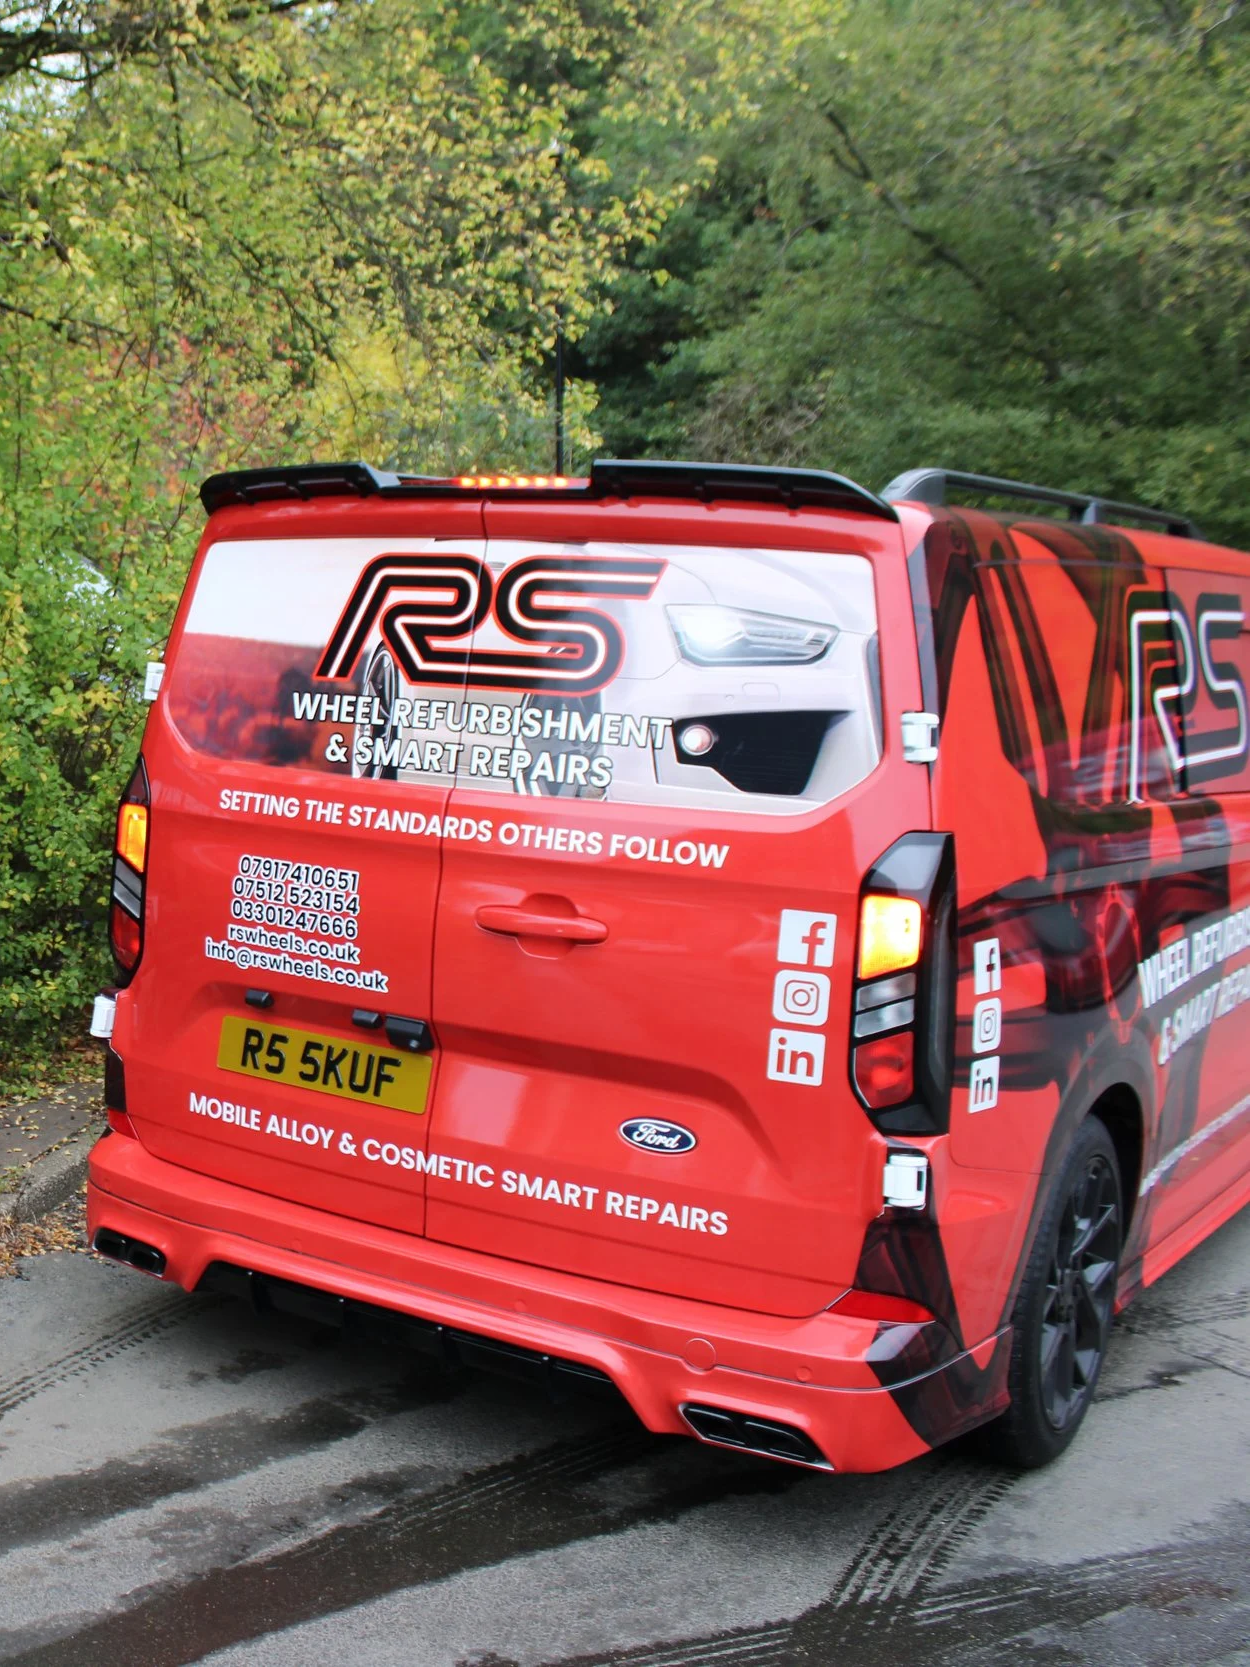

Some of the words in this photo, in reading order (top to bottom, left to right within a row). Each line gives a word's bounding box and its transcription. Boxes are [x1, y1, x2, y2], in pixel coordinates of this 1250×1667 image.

[312, 552, 669, 698] RS
[292, 691, 386, 726] WHEEL
[391, 697, 673, 750] REFURBISHMENT
[1124, 592, 1249, 803] RS
[324, 733, 348, 763] &
[354, 735, 464, 773] SMART
[469, 744, 614, 788] REPAIRS
[219, 789, 300, 818] SETTING
[305, 800, 345, 824] THE
[348, 805, 493, 842] STANDARDS
[498, 822, 603, 855] OTHERS
[609, 834, 730, 868] FOLLOW
[233, 877, 285, 903] 07512
[289, 886, 359, 915] 523154
[240, 855, 359, 892] 07917410651
[228, 925, 360, 963] rswheels.co.uk
[232, 899, 358, 939] 03301247666
[206, 938, 387, 991] info@rswheels.co.uk
[1137, 938, 1191, 1009] WHEEL
[1170, 981, 1221, 1054] SMART
[189, 1092, 260, 1132] MOBILE
[265, 1116, 334, 1150] ALLOY
[338, 1132, 358, 1156] &
[363, 1139, 495, 1188] COSMETIC
[501, 1169, 601, 1211] SMART
[606, 1191, 730, 1236] REPAIRS
[632, 1123, 681, 1148] Ford
